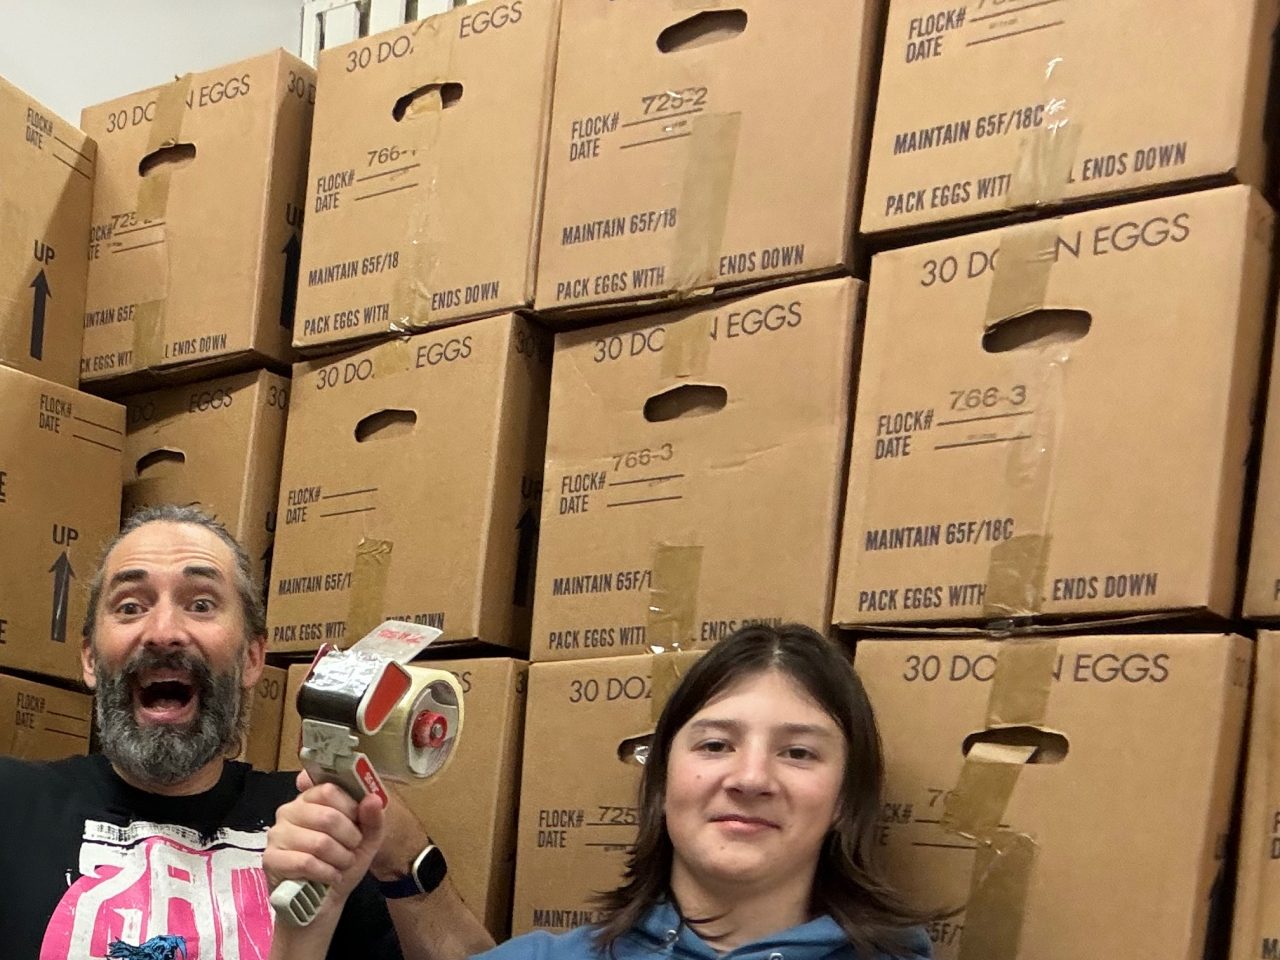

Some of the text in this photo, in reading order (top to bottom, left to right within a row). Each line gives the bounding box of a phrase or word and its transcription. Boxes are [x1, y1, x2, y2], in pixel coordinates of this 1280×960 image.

[908, 7, 967, 40] FLOCK#
[346, 47, 371, 73] 30
[459, 3, 522, 39] EGGS
[906, 36, 944, 63] DATE
[287, 70, 305, 97] 30
[107, 109, 127, 133] 30
[199, 74, 250, 108] EGGS
[25, 128, 43, 150] DATE
[572, 112, 619, 140] FLOCK#
[894, 104, 1045, 156] MAINTAIN 65F/18C
[570, 139, 600, 162] DATE
[1083, 142, 1187, 181] ENDS DOWN
[317, 169, 355, 194] FLOCK#
[315, 192, 340, 213] DATE
[885, 188, 926, 217] PACK
[930, 180, 971, 207] EGGS
[562, 214, 625, 246] MAINTAIN
[33, 239, 55, 266] UP
[720, 244, 805, 276] ENDS DOWN
[921, 212, 1190, 288] 30 EGGS
[308, 260, 358, 287] MAINTAIN
[557, 266, 665, 301] PACK EGGS WITH
[431, 281, 499, 311] ENDS DOWN
[304, 303, 389, 337] PACK EGGS WITH
[593, 337, 623, 363] 30
[726, 301, 803, 340] EGGS
[172, 334, 227, 355] ENDS DOWN
[93, 353, 115, 370] EGGS
[117, 351, 133, 367] WIT
[316, 368, 338, 390] 30
[416, 336, 472, 370] EGGS
[40, 394, 73, 418] FLOCK#
[188, 386, 234, 414] EGGS
[269, 386, 287, 409] 30
[877, 385, 1028, 437] FLOCK# 766-3
[39, 411, 61, 434] DATE
[875, 435, 911, 459] DATE
[561, 471, 606, 495] FLOCK#
[612, 442, 674, 473] 766-3
[288, 486, 321, 507] FLOCK#
[560, 496, 589, 515] DATE
[286, 507, 307, 525] DATE
[53, 523, 79, 548] UP
[865, 518, 1015, 552] MAINTAIN 65F/18C
[279, 574, 322, 596] MAINTAIN
[553, 573, 612, 596] MAINTAIN
[1053, 572, 1158, 601] ENDS DOWN
[858, 589, 898, 613] PACK
[903, 586, 943, 609] EGGS
[273, 622, 323, 642] PACK EGGS
[549, 626, 615, 650] PACK EGGS
[903, 654, 940, 682] 30
[1074, 654, 1170, 684] EGGS
[259, 678, 279, 701] 30
[570, 679, 598, 703] 30
[15, 711, 36, 730] DATE
[539, 809, 584, 828] FLOCK#
[538, 830, 567, 848] DATE
